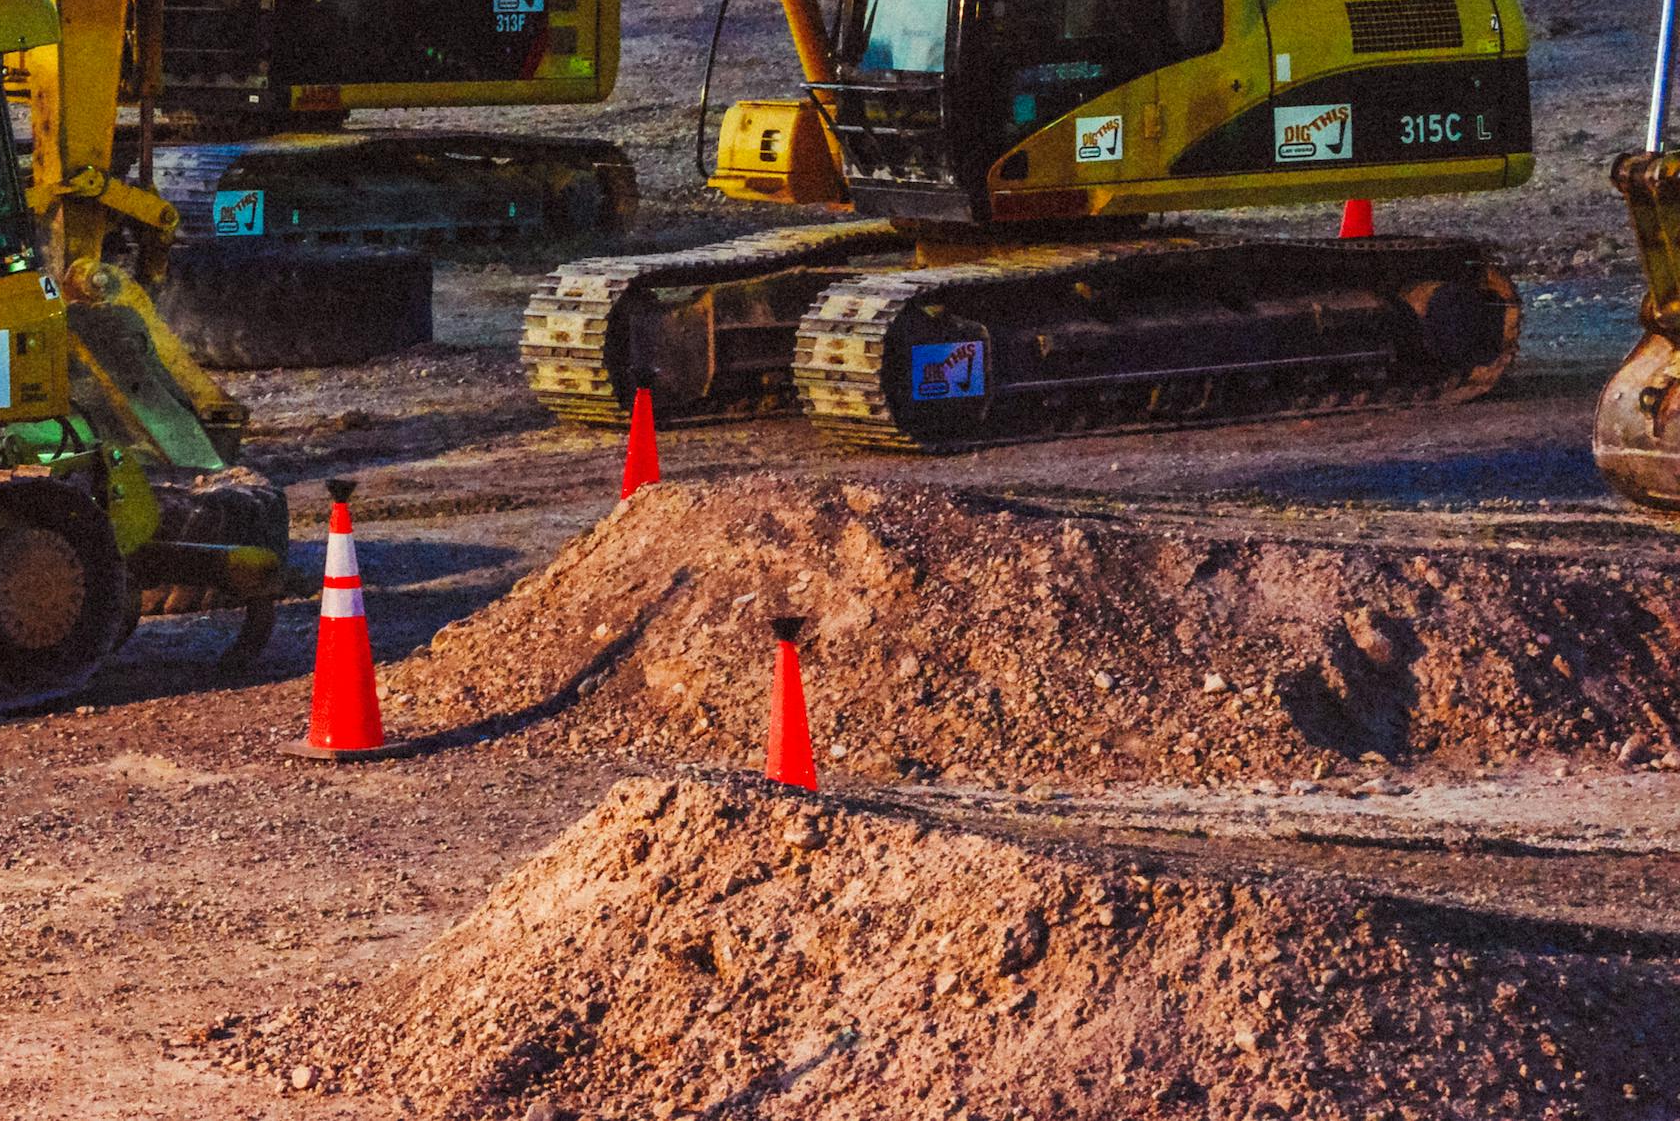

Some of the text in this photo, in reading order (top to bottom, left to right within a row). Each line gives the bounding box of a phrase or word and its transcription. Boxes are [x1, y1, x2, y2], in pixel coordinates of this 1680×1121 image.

[496, 14, 525, 32] 313F
[1284, 106, 1349, 143] DIG THIS
[1400, 113, 1492, 144] 315C L
[44, 277, 57, 297] 4
